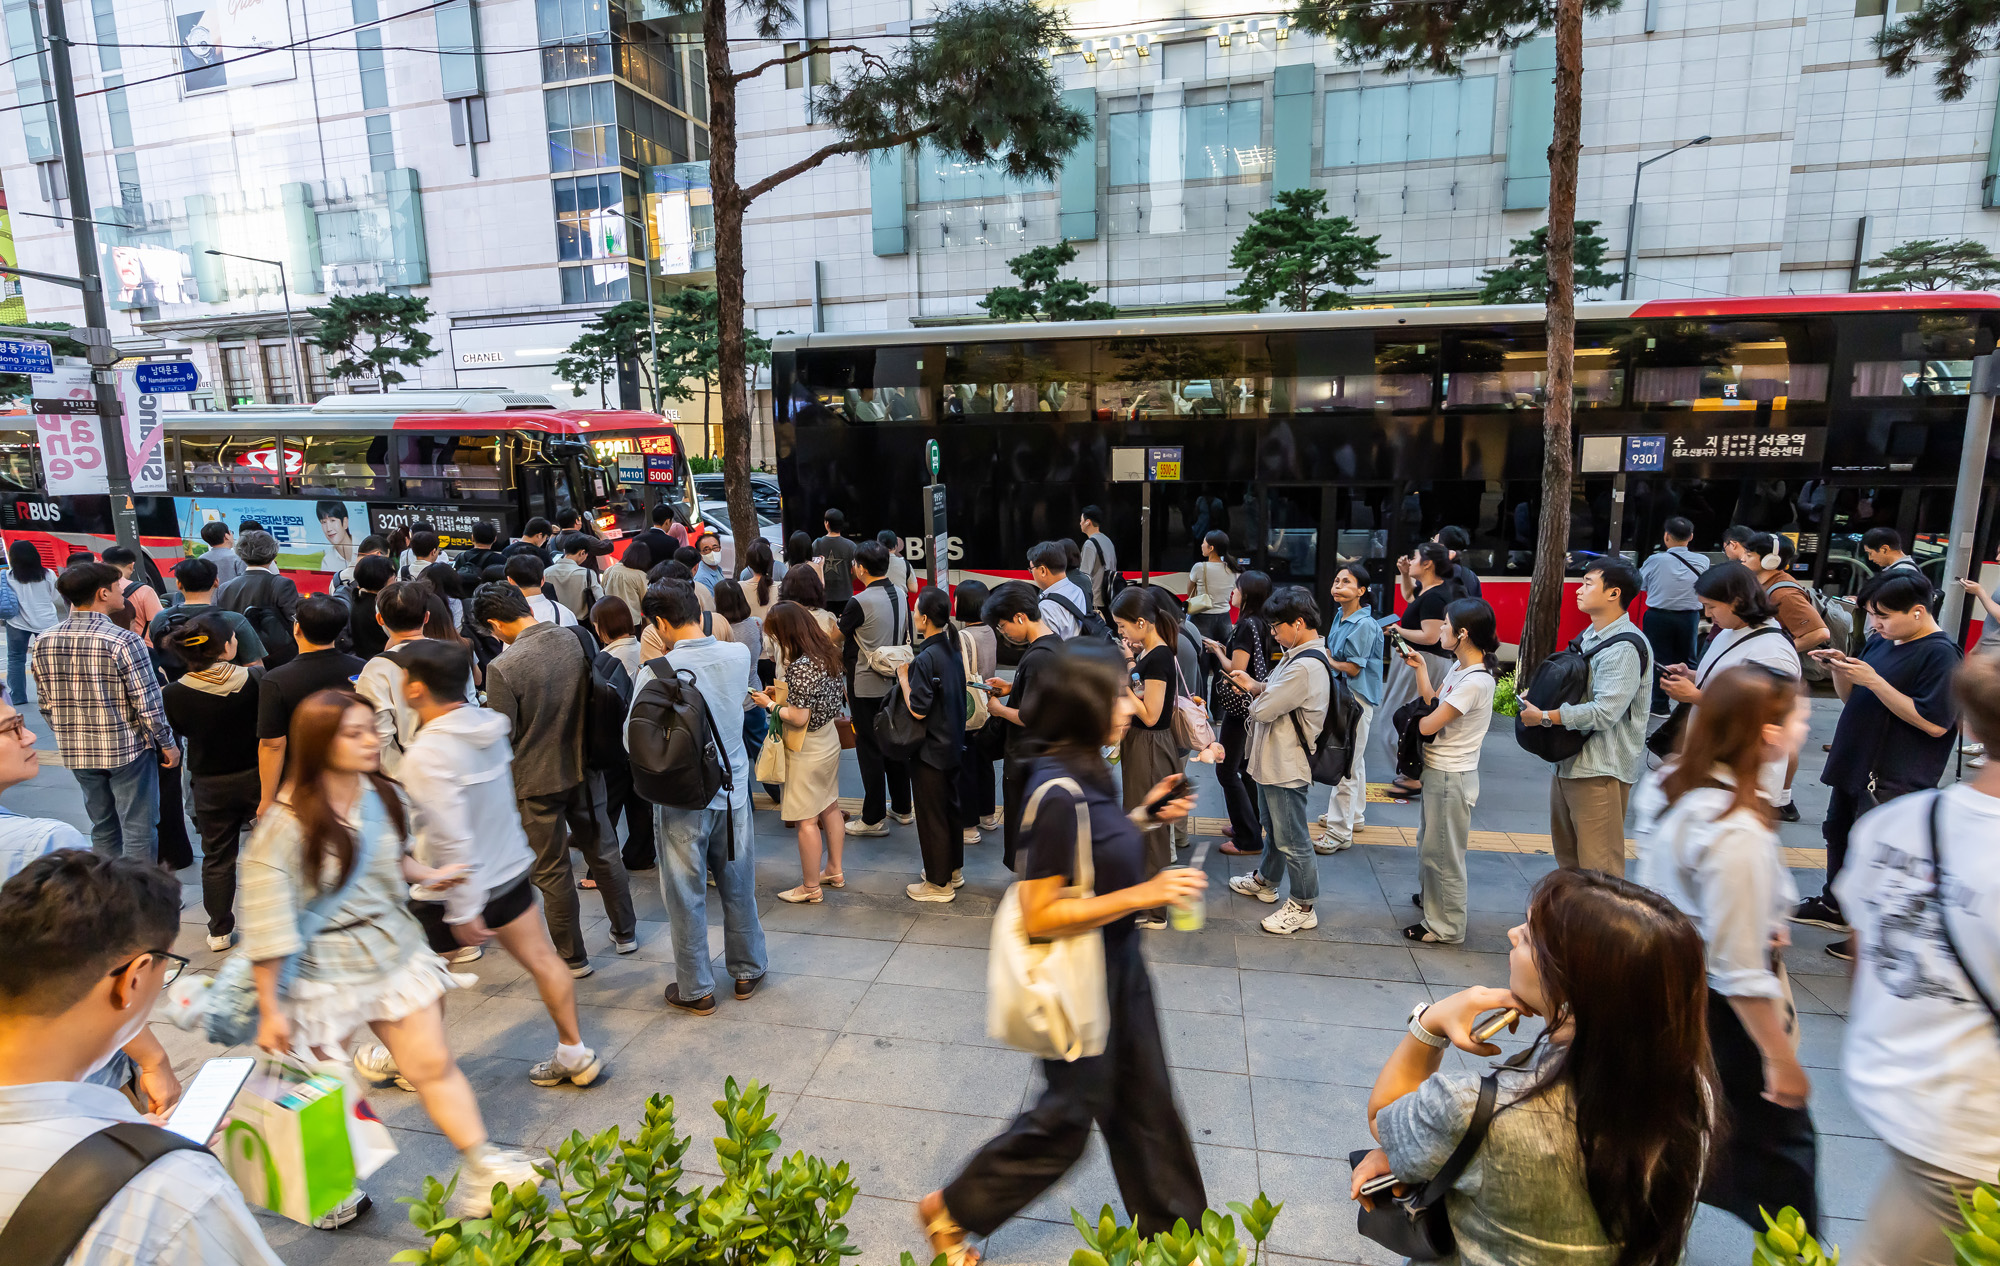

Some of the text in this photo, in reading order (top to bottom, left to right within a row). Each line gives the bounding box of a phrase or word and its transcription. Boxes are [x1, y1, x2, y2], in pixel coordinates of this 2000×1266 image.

[462, 352, 504, 363] CHANEL
[151, 366, 179, 376] 남대문로
[1758, 434, 1806, 446] 서울역
[1758, 446, 1804, 456] 환승센터
[1632, 454, 1658, 464] 9301
[620, 470, 643, 478] M4101
[1160, 464, 1177, 476] 5500-2
[650, 471, 672, 480] 5000
[378, 514, 408, 530] 3201
